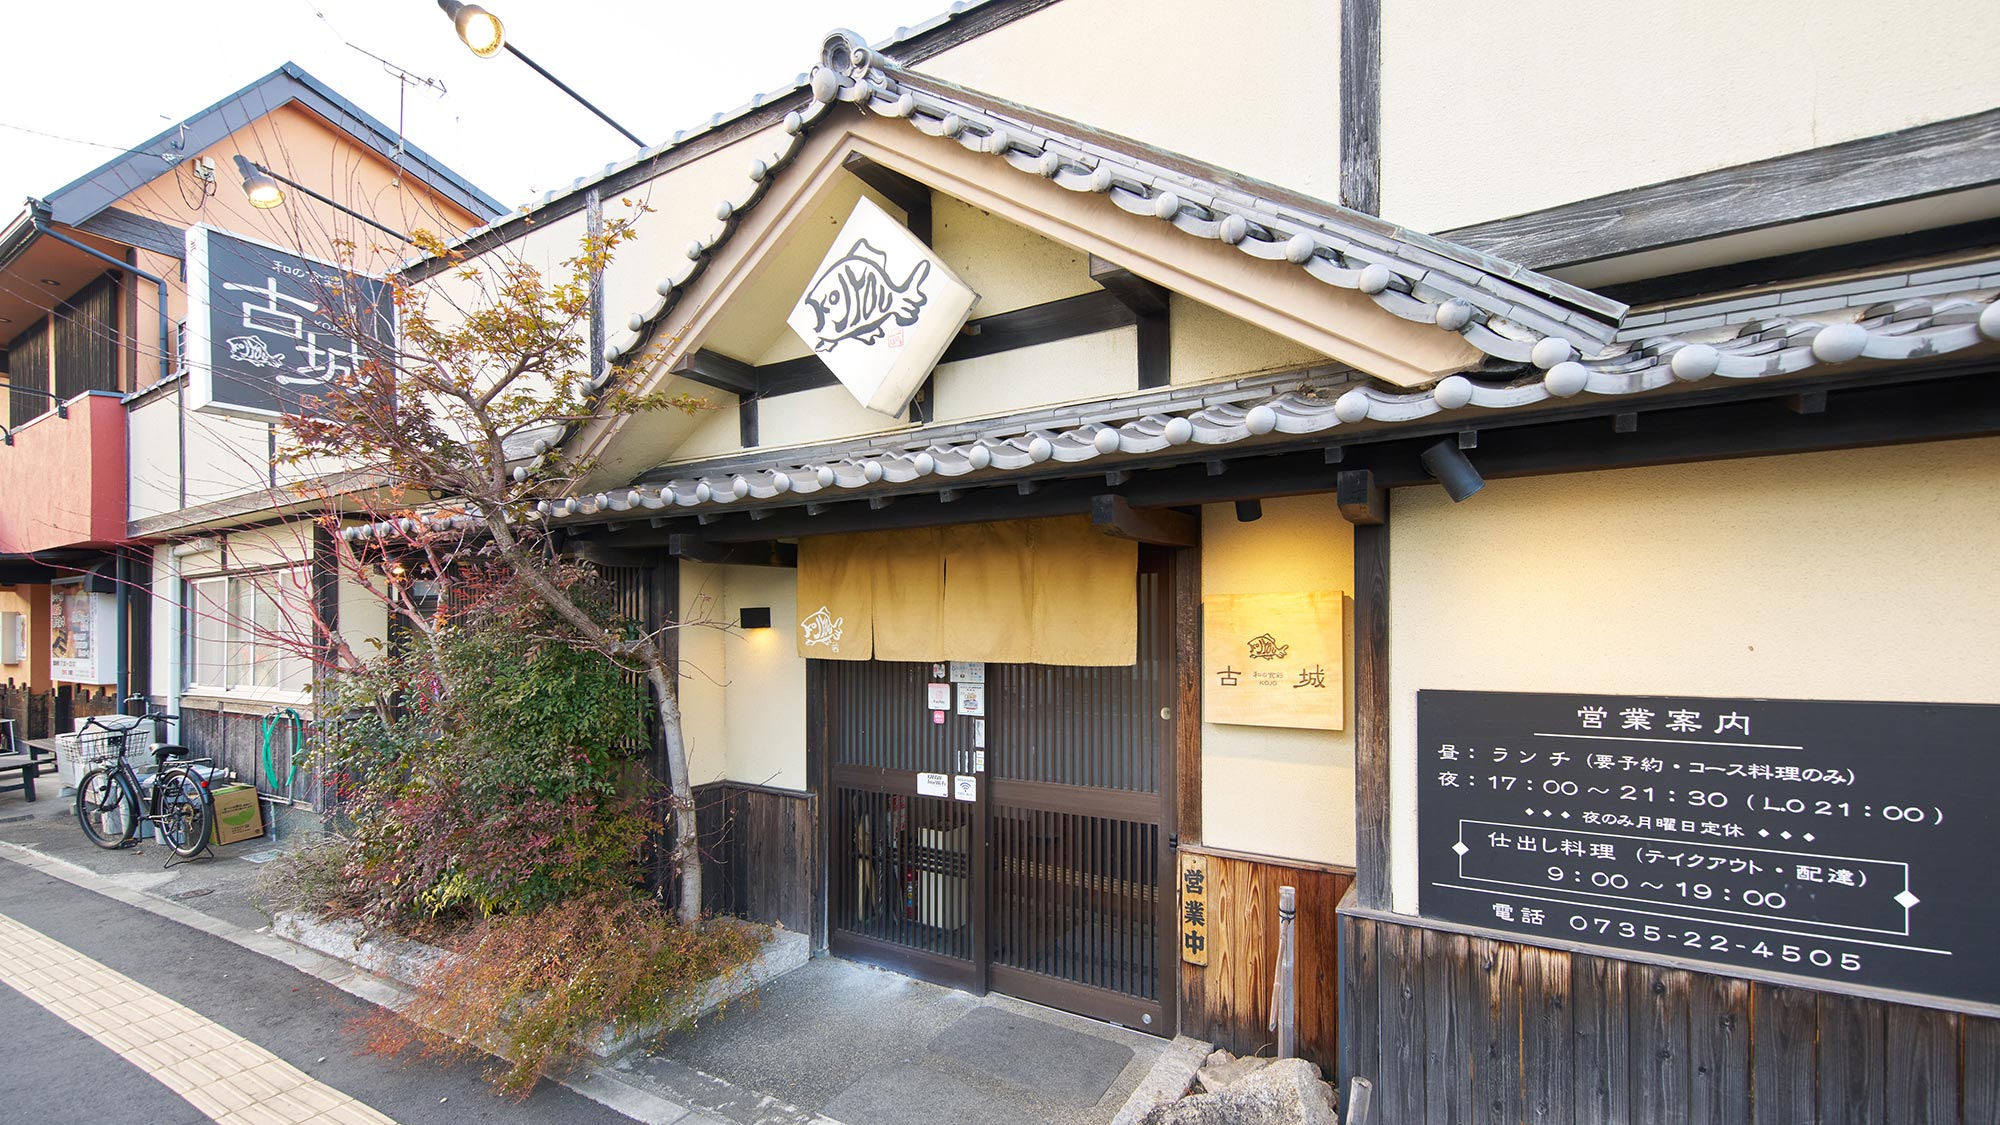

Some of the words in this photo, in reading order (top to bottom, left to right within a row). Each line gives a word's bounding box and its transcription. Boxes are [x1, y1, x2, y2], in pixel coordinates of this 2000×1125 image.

[1577, 705, 1750, 736] 営業案内
[1582, 810, 1745, 838] 夜のみ月曜日定休
[1184, 869, 1205, 955] 営業中
[1492, 902, 1546, 926] 電話
[1569, 915, 1862, 971] 0735-22-4505
